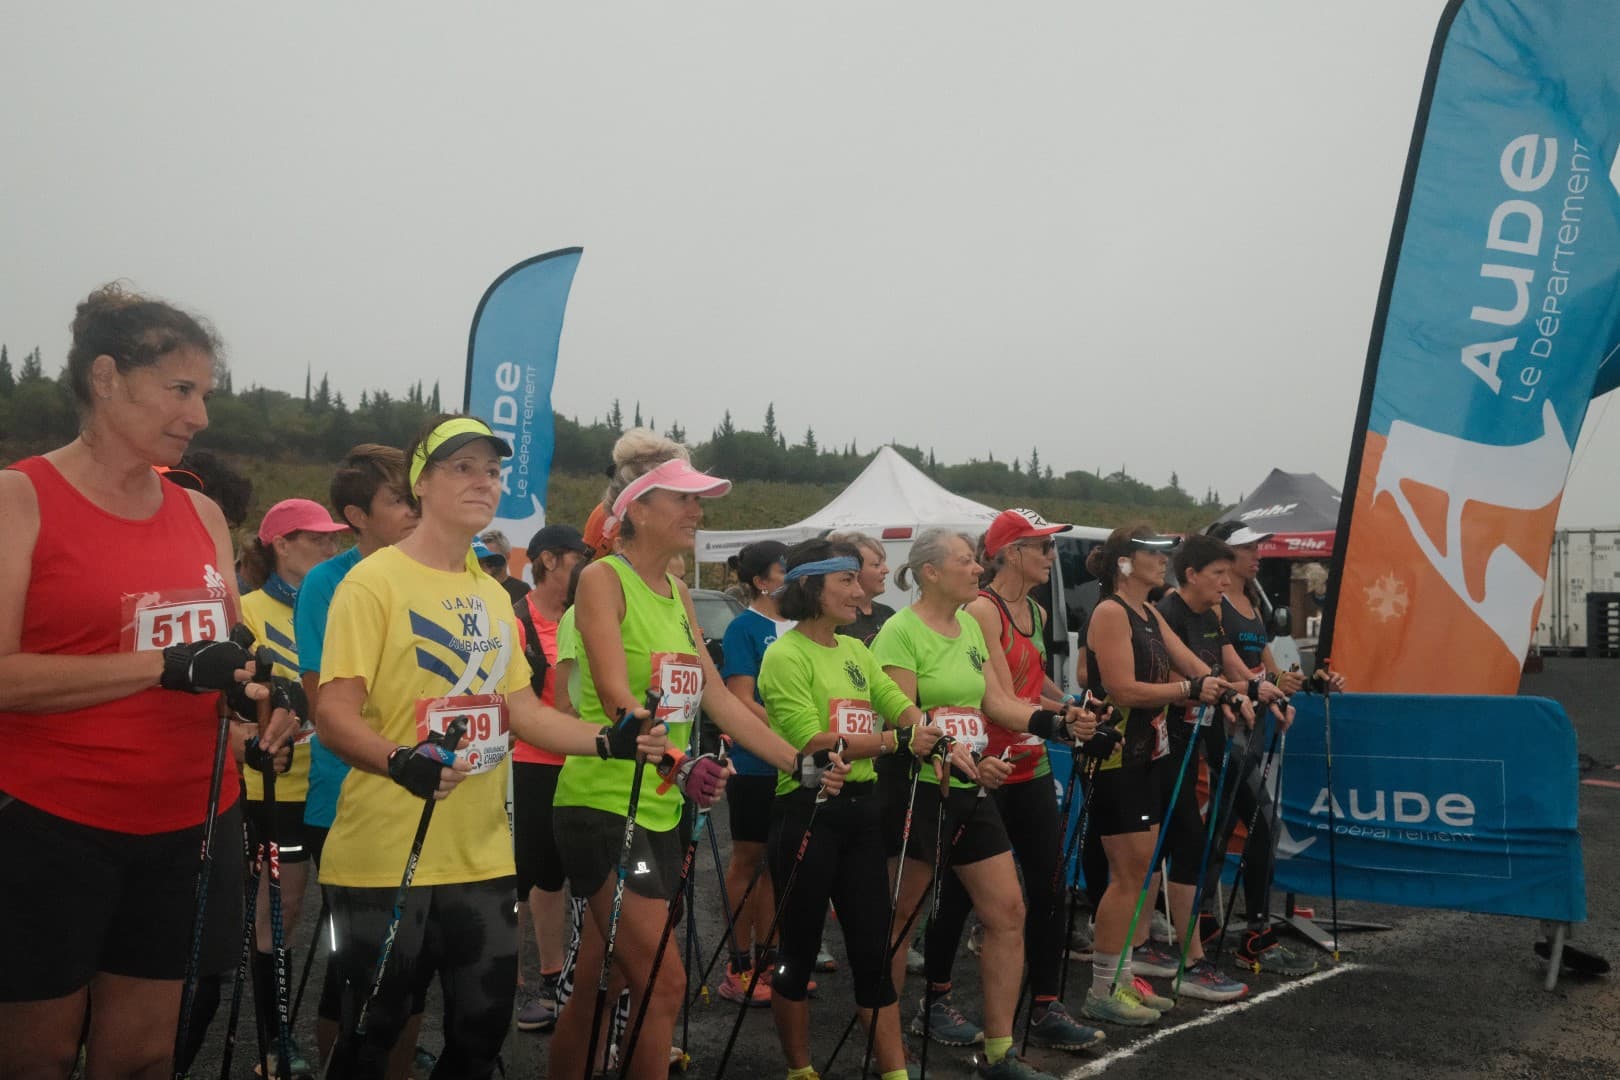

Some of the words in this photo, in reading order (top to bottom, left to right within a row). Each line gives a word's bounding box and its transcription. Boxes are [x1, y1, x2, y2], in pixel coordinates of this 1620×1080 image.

[1511, 366, 1543, 403] Le
[516, 479, 529, 499] Le
[151, 608, 217, 648] 515
[449, 636, 503, 653] AUBAGNE
[670, 669, 698, 696] 520
[944, 718, 979, 738] 519
